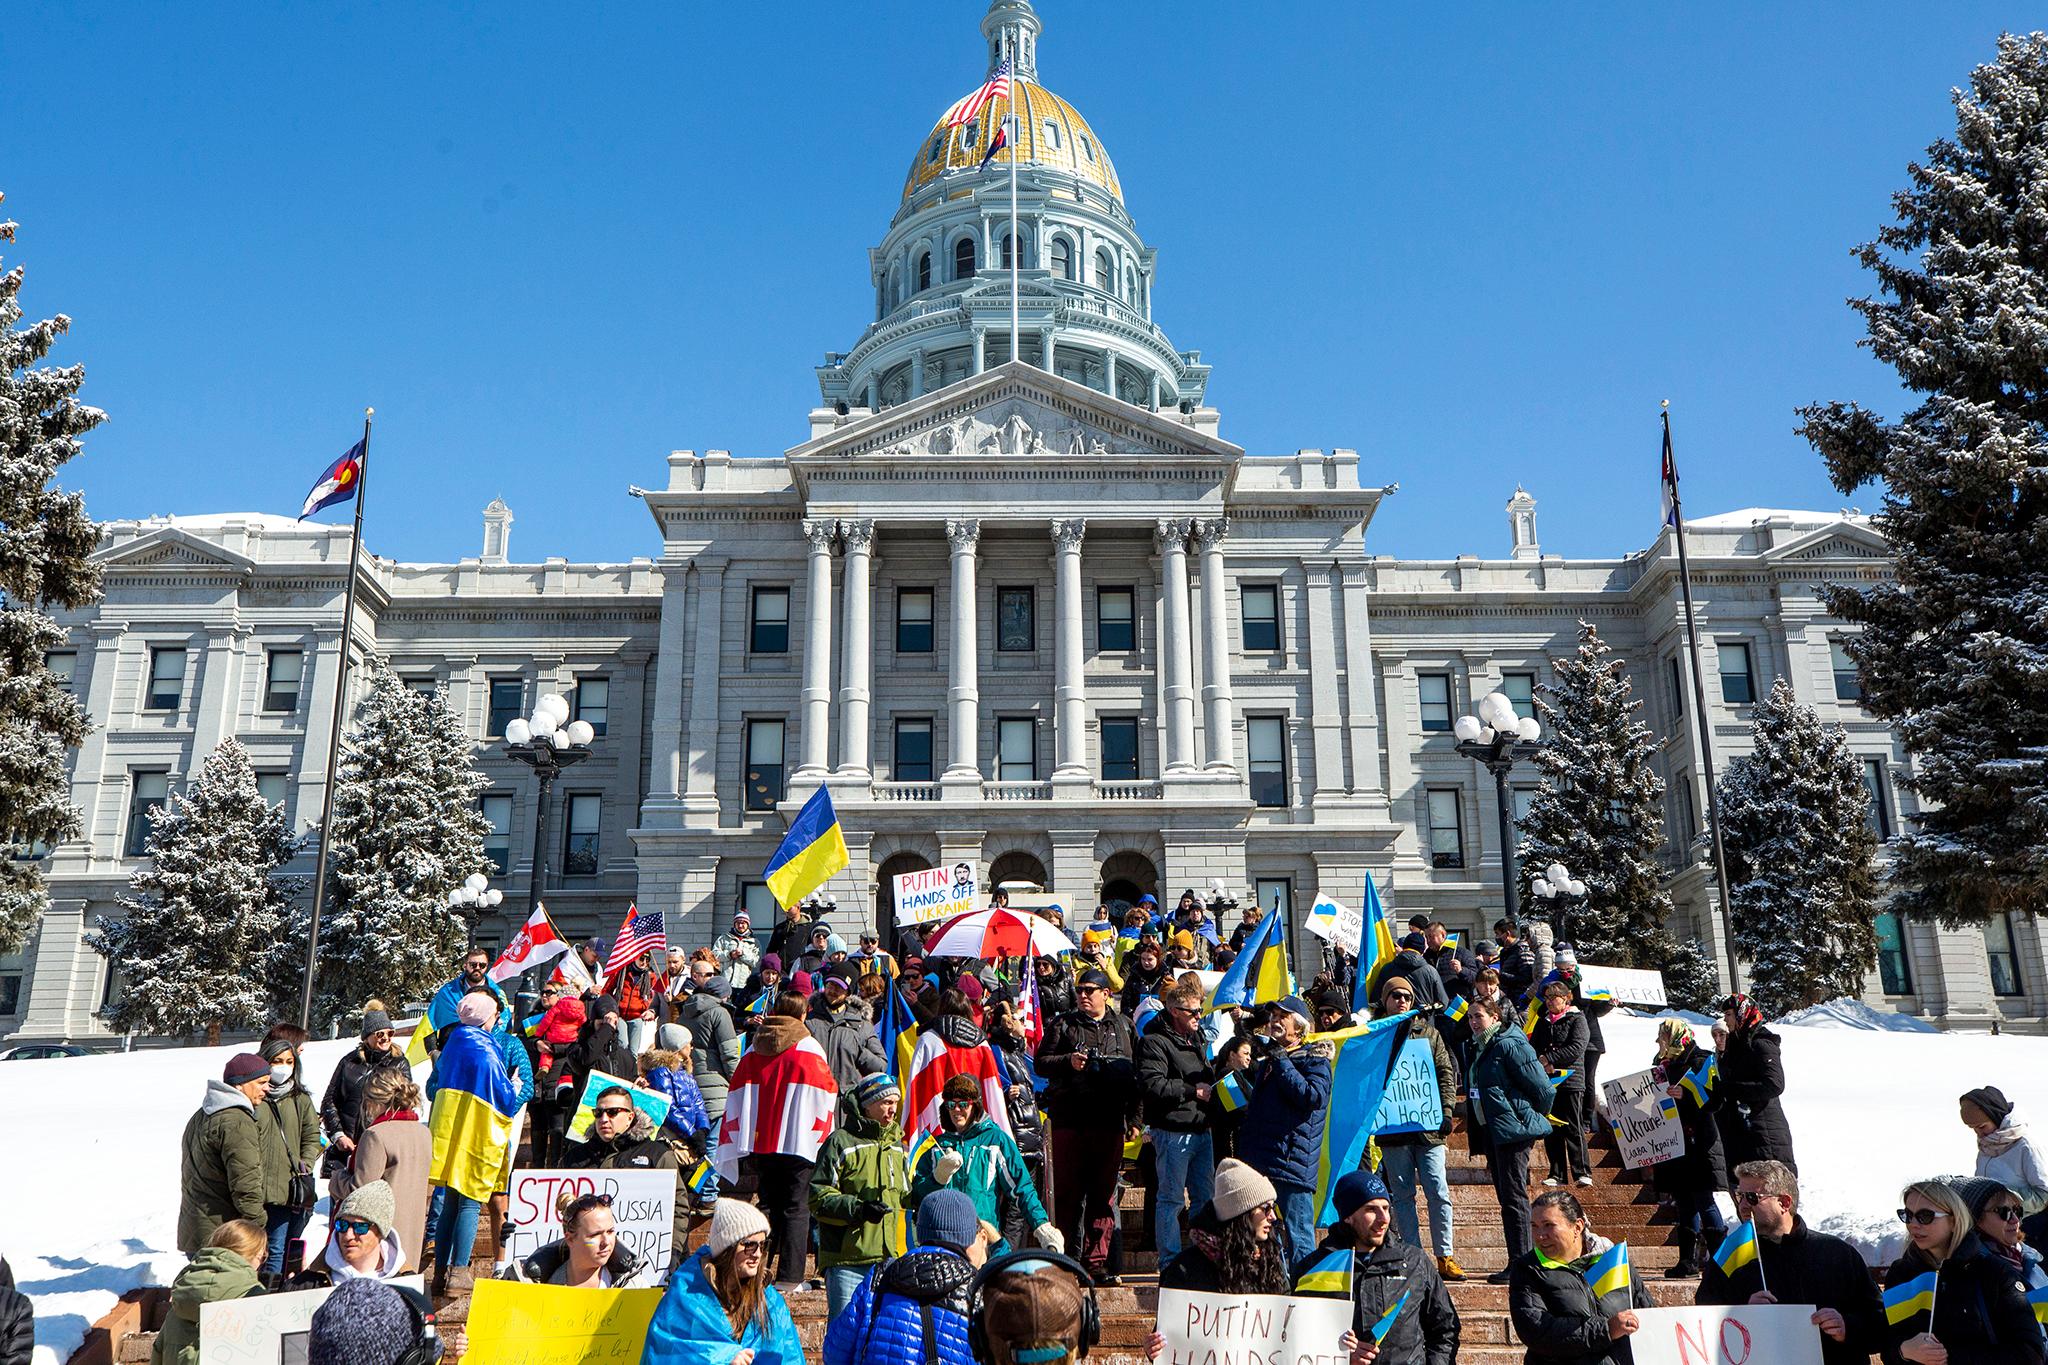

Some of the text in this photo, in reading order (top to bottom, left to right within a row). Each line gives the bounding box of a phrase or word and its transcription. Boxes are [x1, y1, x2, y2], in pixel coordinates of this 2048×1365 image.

[901, 868, 949, 893] PUTIN
[902, 885, 975, 909] HANDS OFF
[915, 897, 974, 923] UKRAINE
[1631, 1075, 1662, 1099] with
[1618, 1104, 1666, 1143] Ukraine!
[1674, 1316, 1752, 1365] NO
